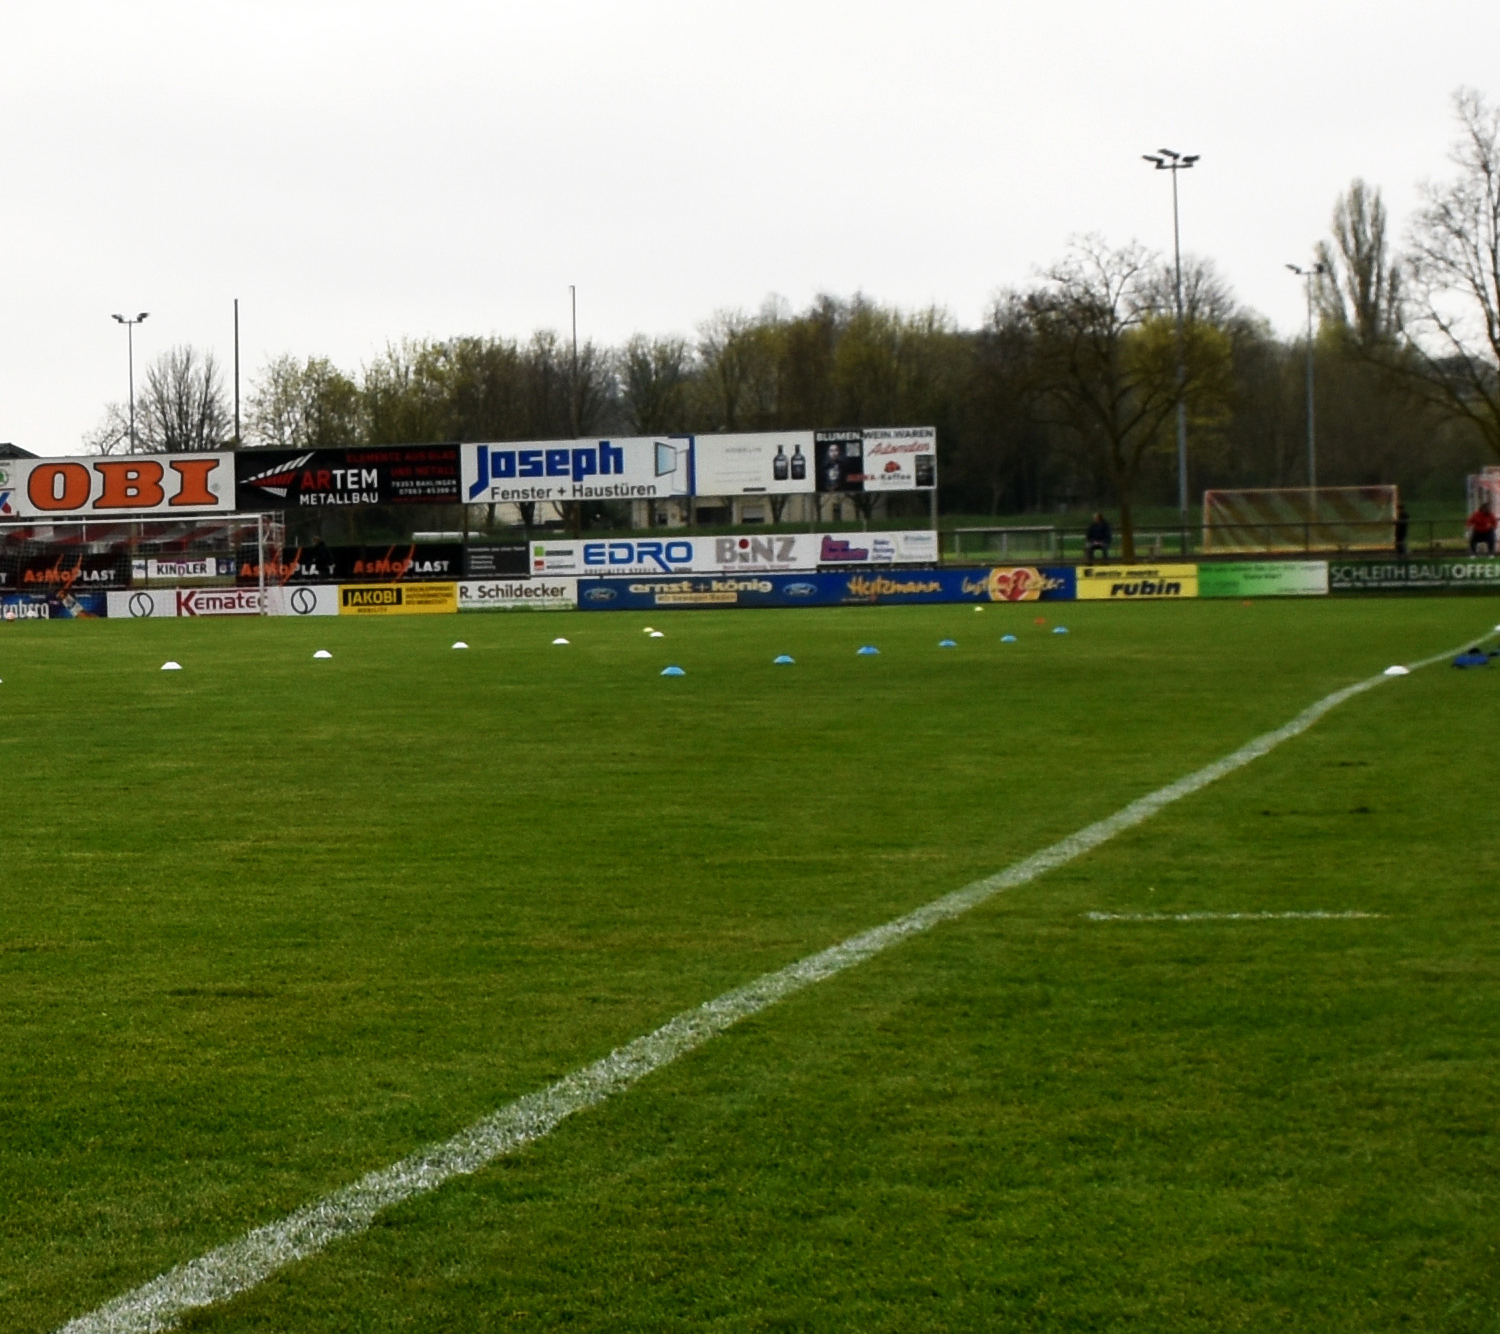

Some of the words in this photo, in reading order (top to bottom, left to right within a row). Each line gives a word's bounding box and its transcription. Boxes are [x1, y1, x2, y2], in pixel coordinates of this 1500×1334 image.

[301, 468, 378, 490] ARTEM
[468, 441, 624, 500] Joseph
[27, 458, 220, 512] OBI
[490, 485, 555, 501] Fenster
[571, 481, 657, 499] Haustüren
[300, 491, 379, 505] METALLBAU
[583, 540, 694, 573] EDRO
[156, 562, 208, 577] KINDLER
[1331, 566, 1406, 582] SCHLEITH
[459, 585, 473, 599] R.
[477, 582, 567, 599] Schildecker
[711, 577, 773, 594] könig
[1110, 579, 1181, 597] rubin
[346, 589, 398, 605] JAKOBI
